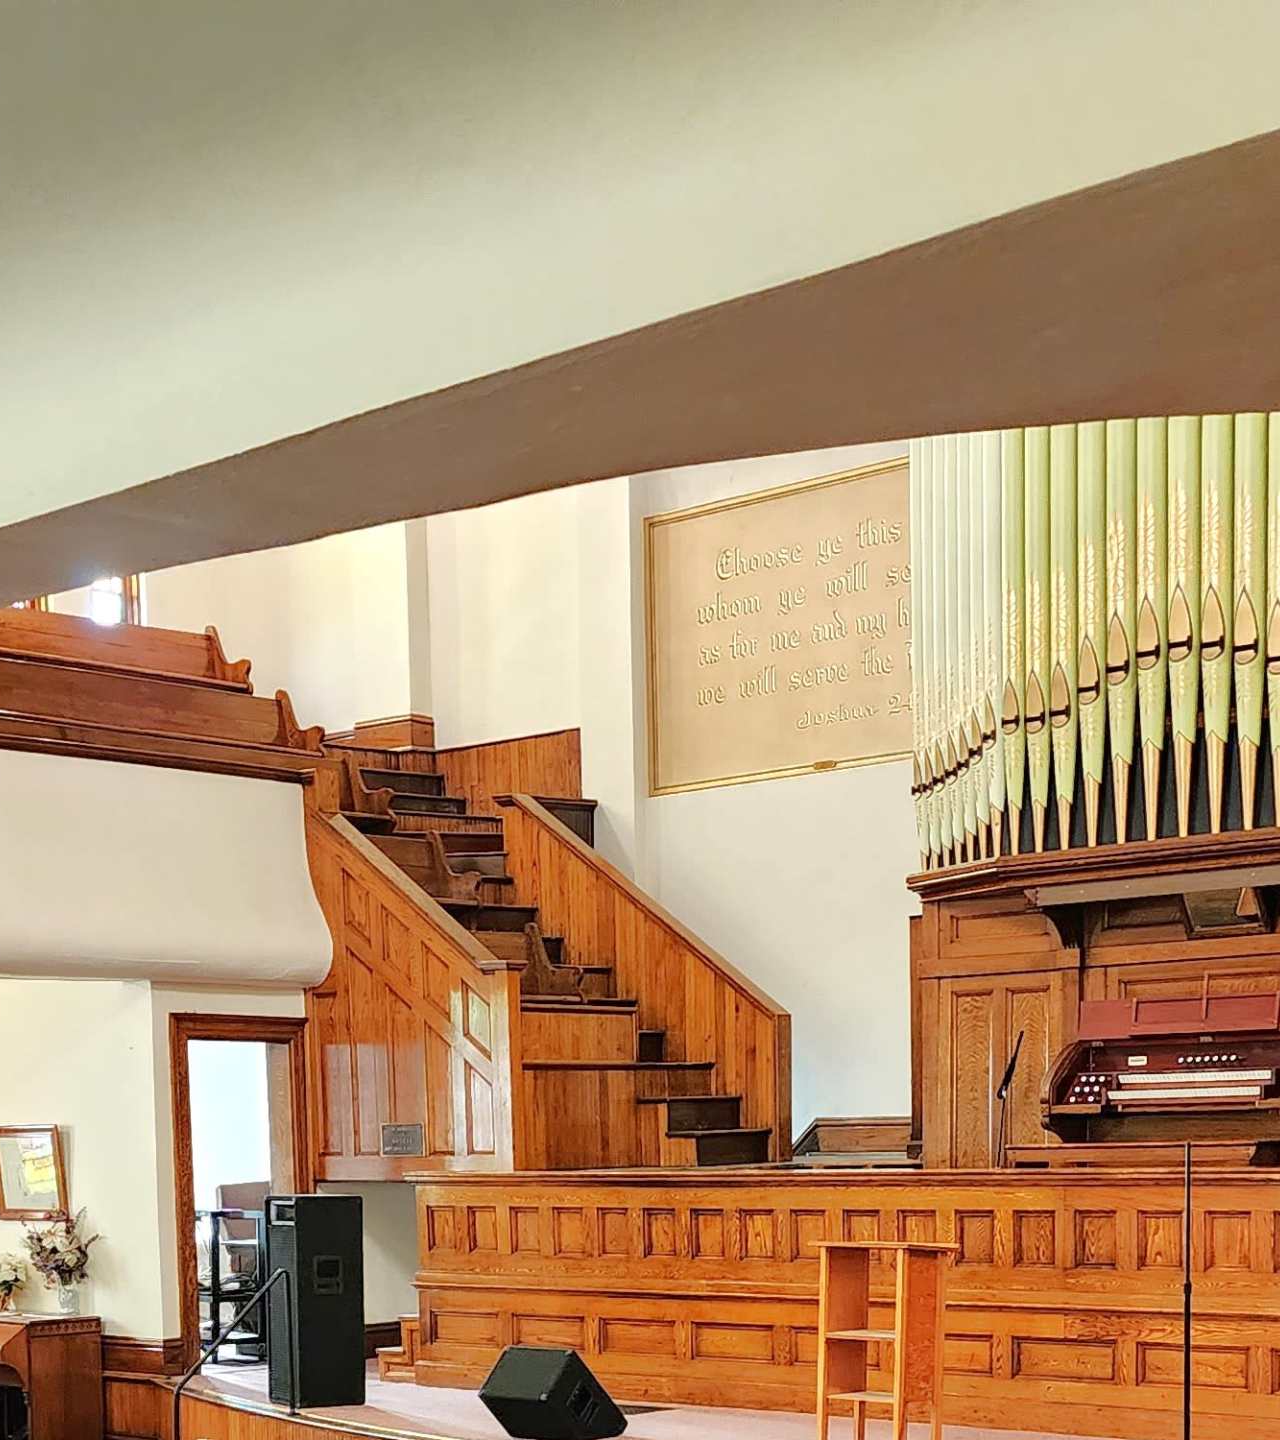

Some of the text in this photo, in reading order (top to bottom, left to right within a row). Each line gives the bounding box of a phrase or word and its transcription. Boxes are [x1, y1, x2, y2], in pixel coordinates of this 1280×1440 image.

[715, 515, 904, 581] Choose ye this
[696, 591, 762, 625] whom
[776, 585, 807, 616] ye
[825, 560, 869, 598] will
[698, 642, 722, 667] as
[728, 628, 759, 660] for
[770, 629, 802, 653] me
[809, 609, 848, 645] and
[855, 612, 888, 640] my
[696, 684, 728, 706] we
[738, 663, 778, 698] will
[787, 661, 851, 693] serve
[860, 645, 895, 677] the
[796, 702, 880, 730] Joshua
